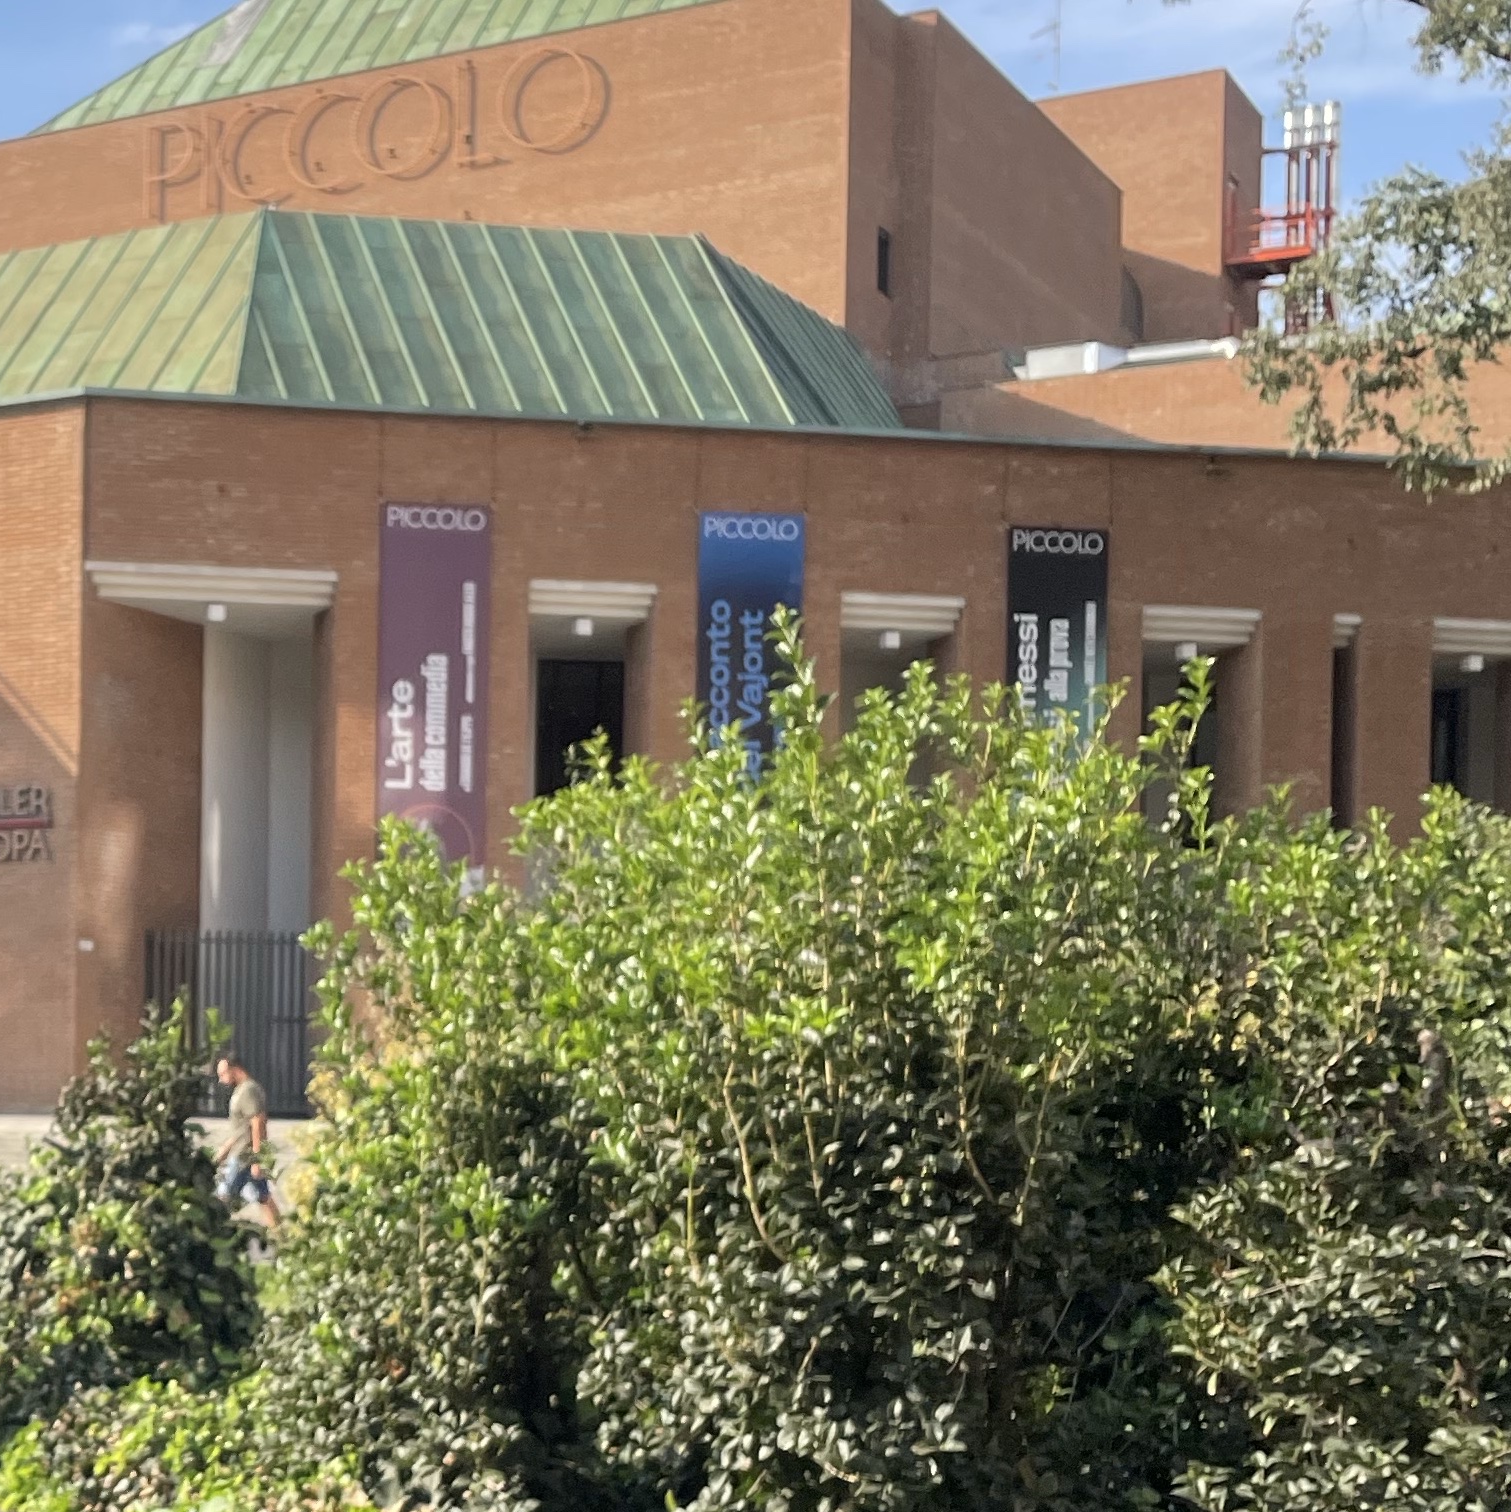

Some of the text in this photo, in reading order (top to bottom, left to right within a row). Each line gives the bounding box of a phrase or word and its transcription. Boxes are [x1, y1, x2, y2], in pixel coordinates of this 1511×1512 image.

[143, 47, 606, 222] PICCOLO
[387, 506, 486, 531] PICCOLO
[704, 516, 799, 542] PICCOLO
[1012, 529, 1104, 555] PICCOLO
[384, 677, 415, 790] L'arte
